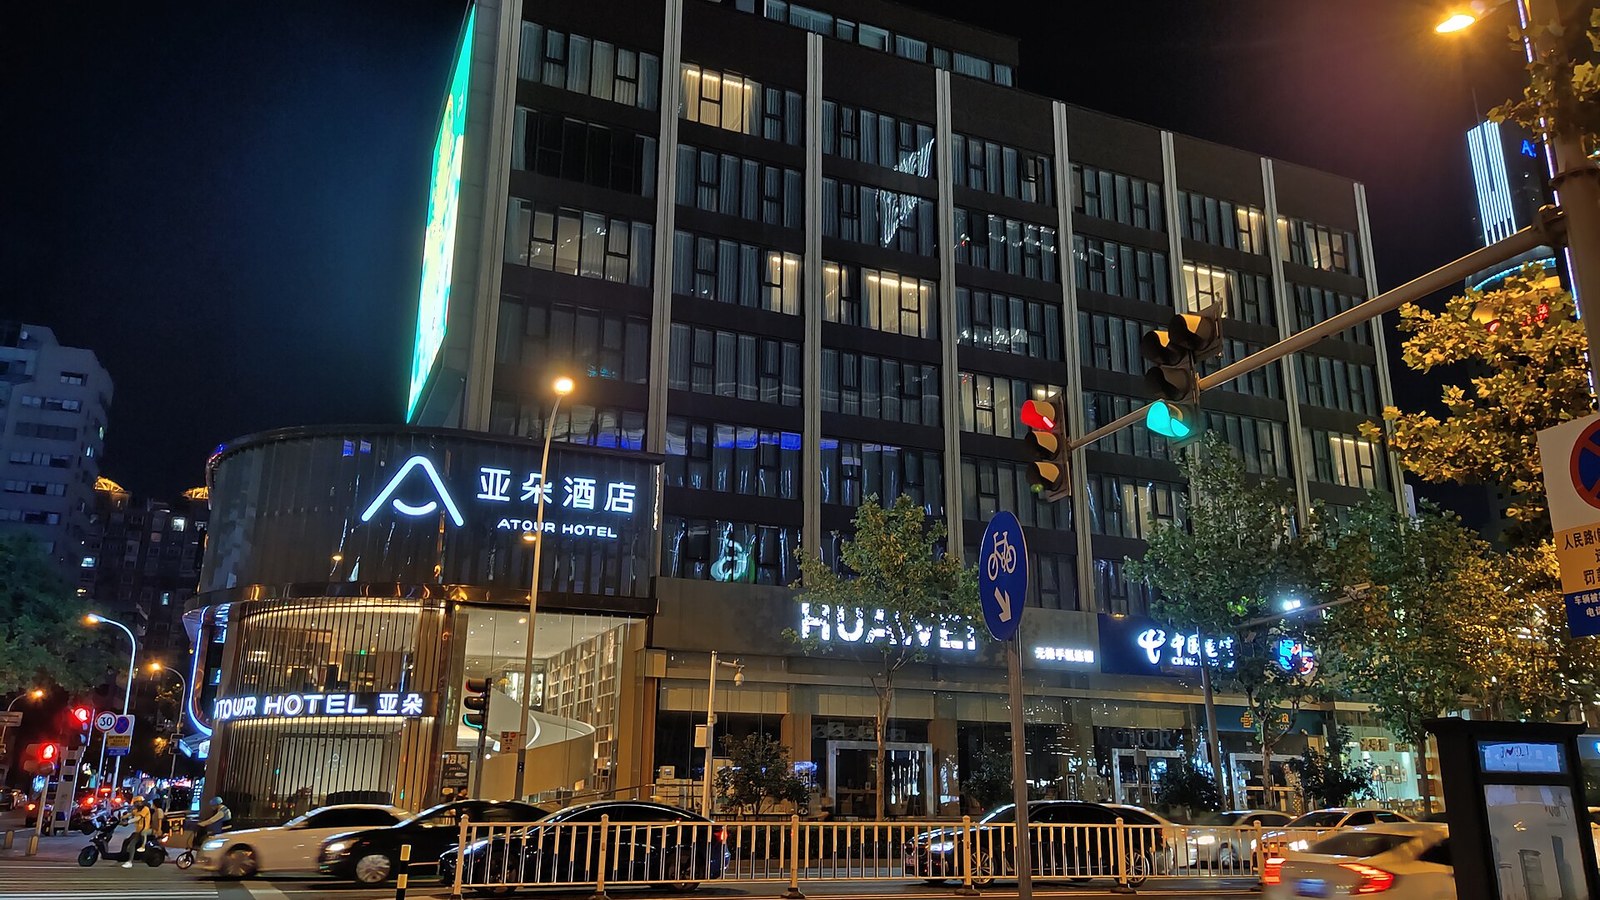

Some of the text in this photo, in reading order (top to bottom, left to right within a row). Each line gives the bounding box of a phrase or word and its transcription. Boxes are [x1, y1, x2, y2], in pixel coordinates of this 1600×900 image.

[476, 466, 636, 513] 亚朵酒店
[496, 518, 618, 539] ATOUR HOTEL
[1574, 592, 1600, 606] 车辆被
[213, 693, 424, 720] ATOUR HOTEL 亚朵
[99, 716, 113, 727] 30
